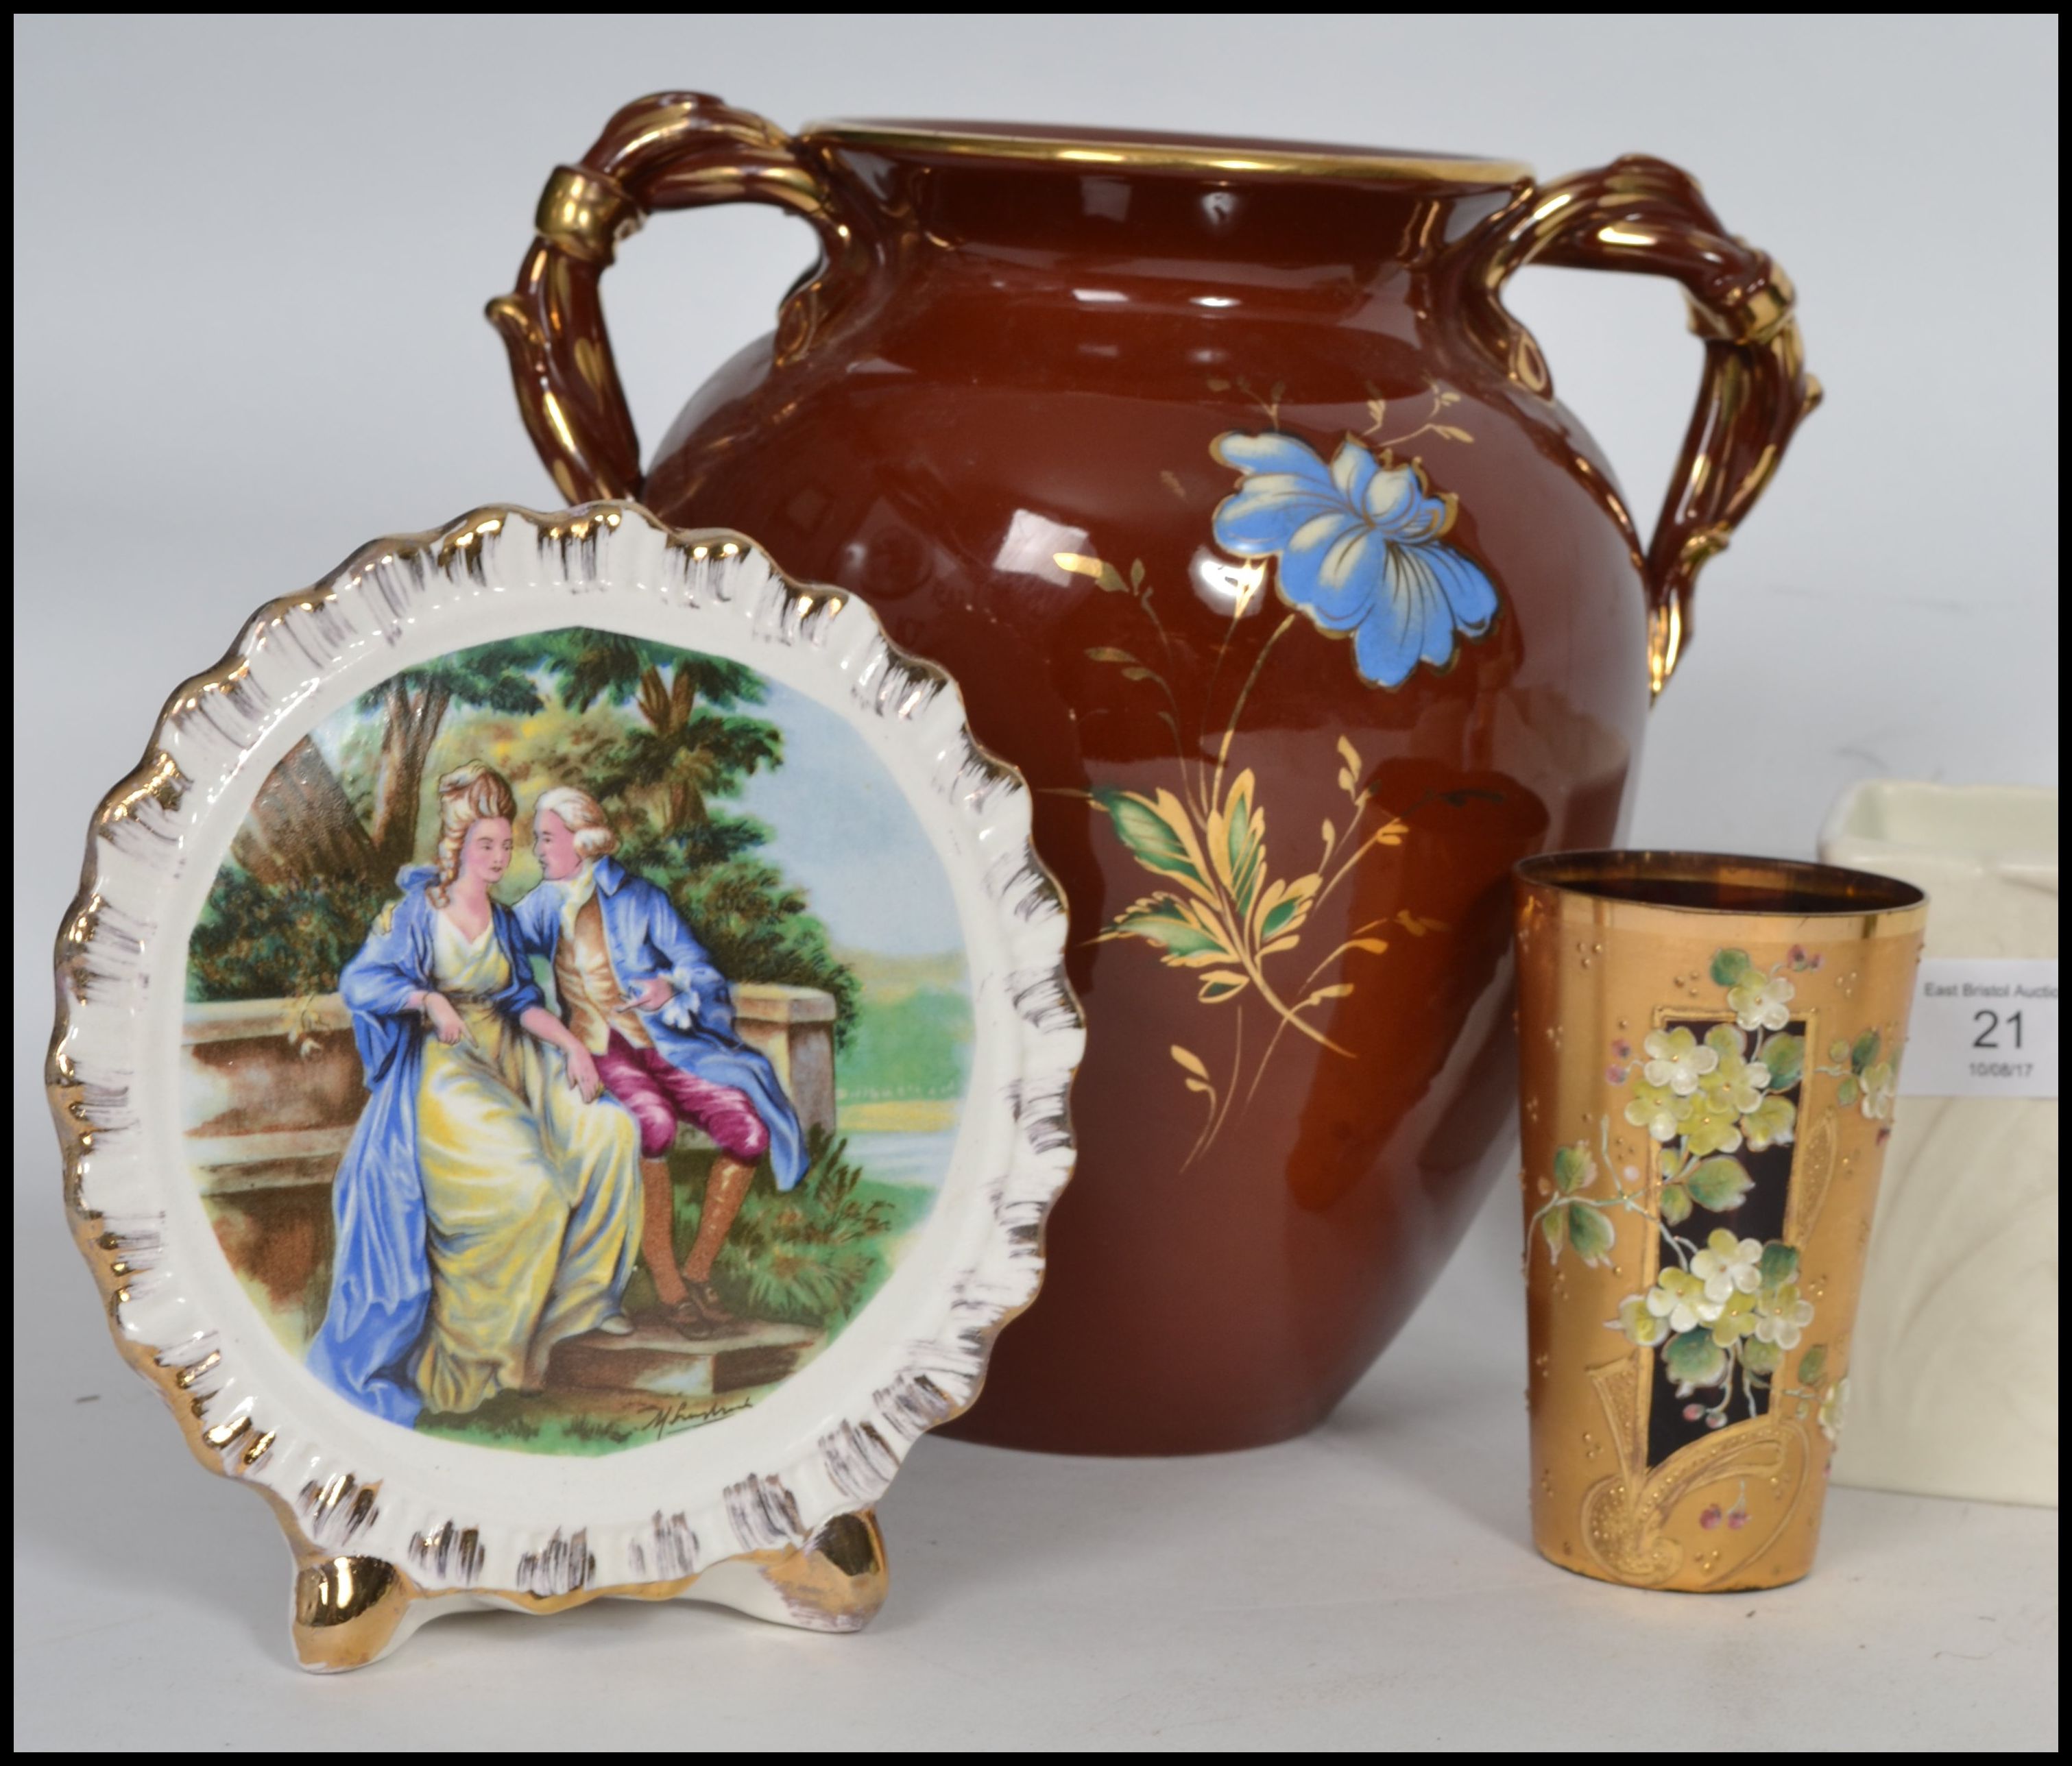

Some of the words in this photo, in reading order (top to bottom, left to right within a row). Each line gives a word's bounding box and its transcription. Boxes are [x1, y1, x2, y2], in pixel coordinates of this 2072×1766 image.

[1925, 982, 1958, 997] East
[1963, 983, 2010, 997] Bristol
[1973, 1010, 2021, 1049] 21
[1970, 1063, 2033, 1077] 10/08/17
